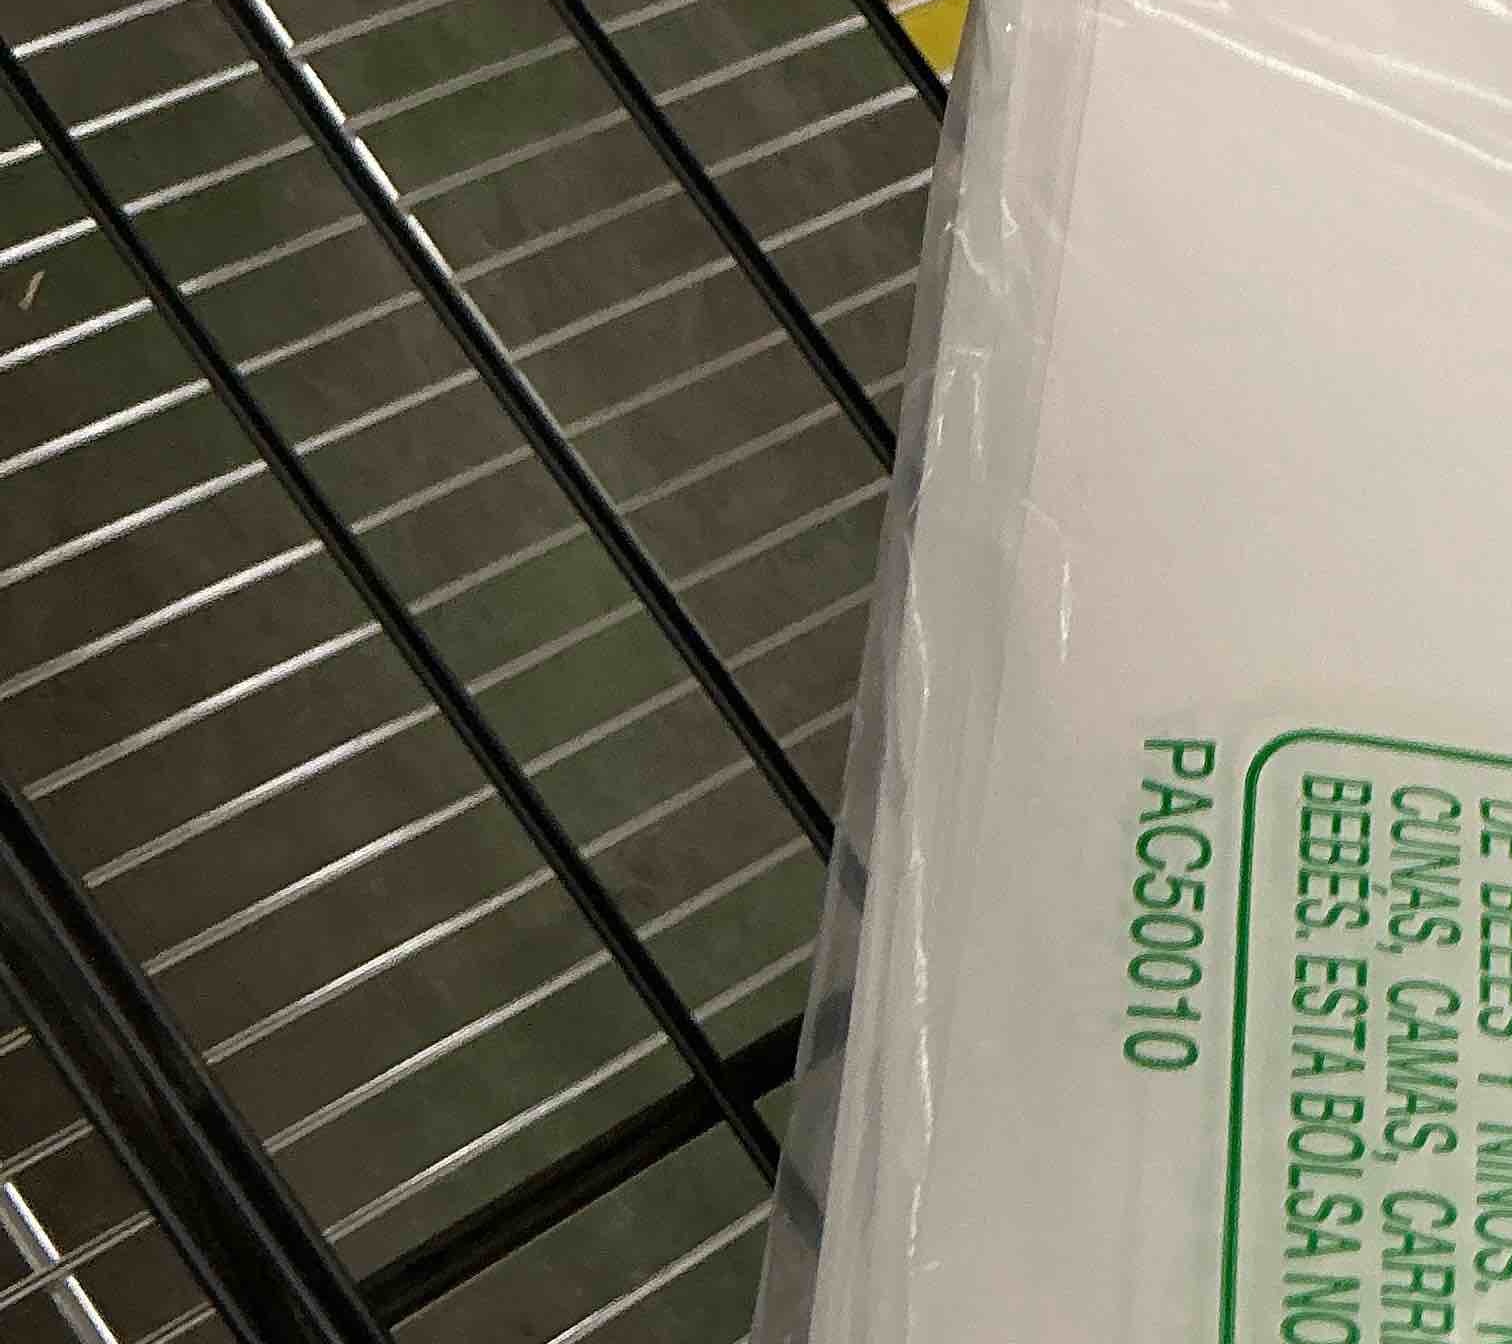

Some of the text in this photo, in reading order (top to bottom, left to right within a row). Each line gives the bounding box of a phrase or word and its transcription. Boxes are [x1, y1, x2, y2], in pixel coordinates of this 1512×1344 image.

[1122, 738, 1215, 1072] PAC50010
[1294, 773, 1387, 939] BEBÉS.
[1375, 786, 1462, 954] CUNAS,
[1291, 954, 1368, 1078] ESTA
[1372, 980, 1462, 1164] CAMAS,
[1283, 1093, 1367, 1259] BOLSA
